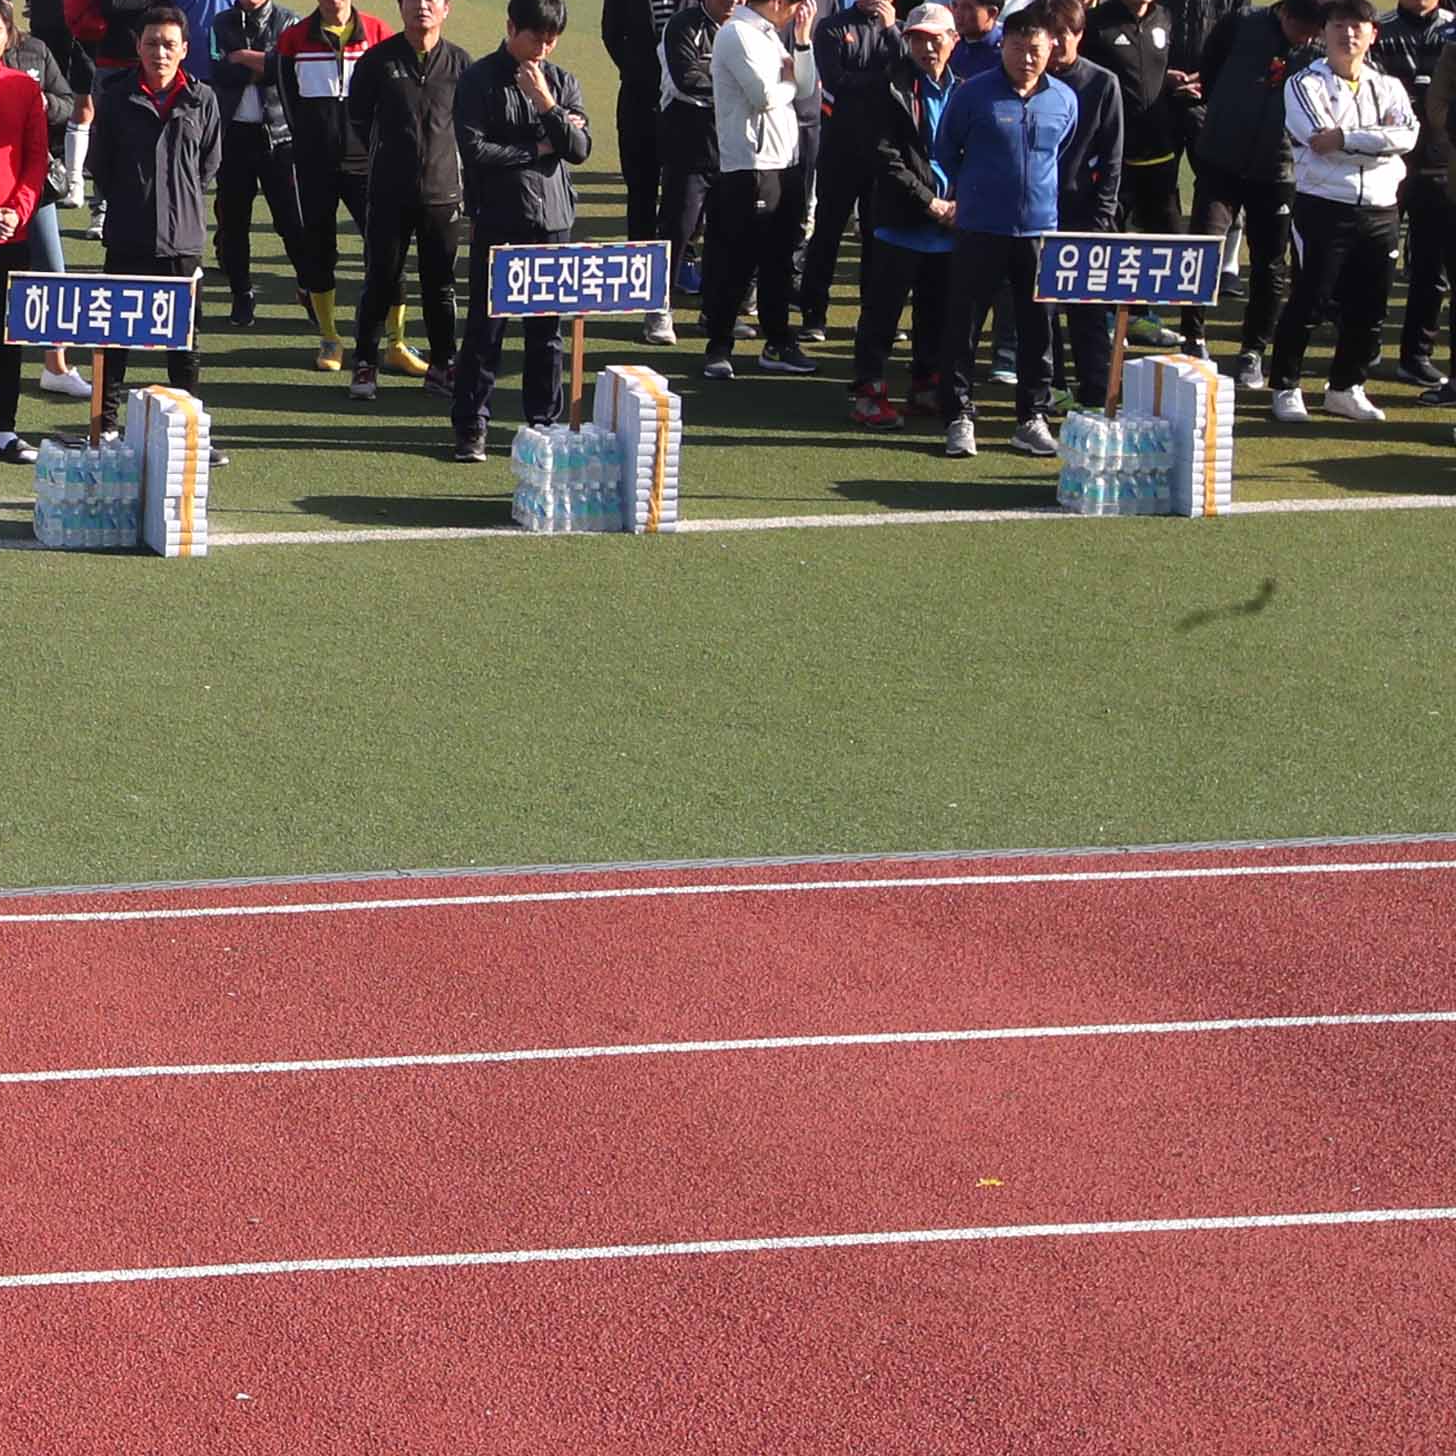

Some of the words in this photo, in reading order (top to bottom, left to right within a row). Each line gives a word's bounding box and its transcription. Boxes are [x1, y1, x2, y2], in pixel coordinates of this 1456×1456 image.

[507, 253, 652, 304] 화도진축구회
[1055, 244, 1205, 295] 유일축구회
[24, 285, 176, 339] 하나축구회
